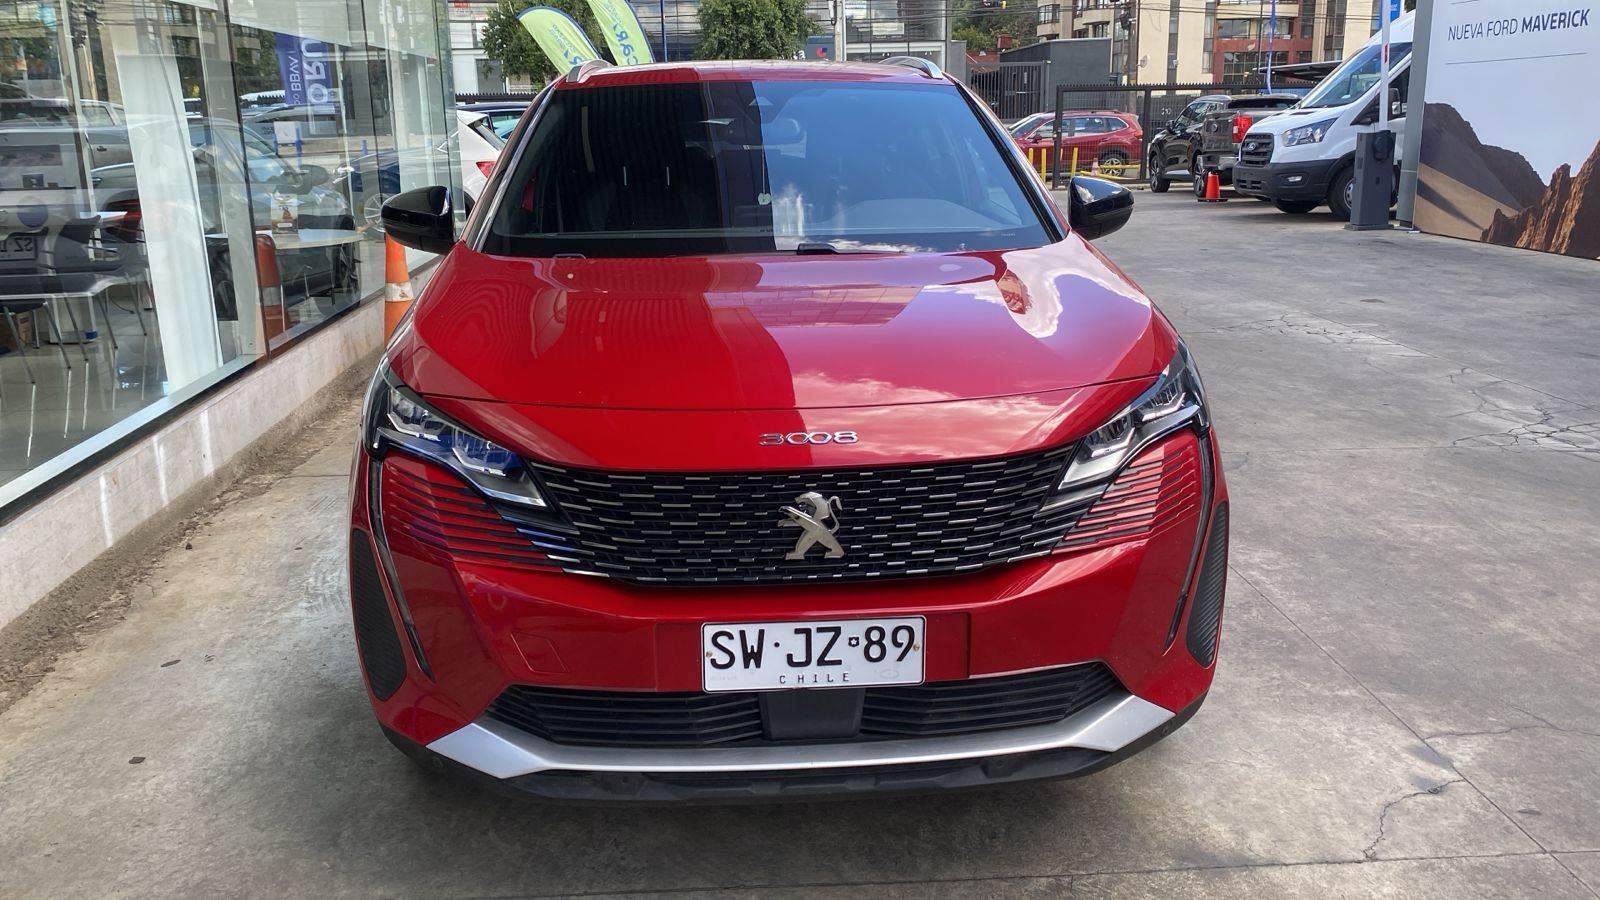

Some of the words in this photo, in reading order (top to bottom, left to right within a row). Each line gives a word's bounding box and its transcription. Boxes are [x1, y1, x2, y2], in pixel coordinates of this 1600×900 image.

[1448, 22, 1483, 41] NUEVA
[1486, 18, 1518, 38] FORD
[1521, 8, 1591, 33] MAVERICK
[759, 431, 860, 446] 3008
[779, 672, 850, 685] CHILE
